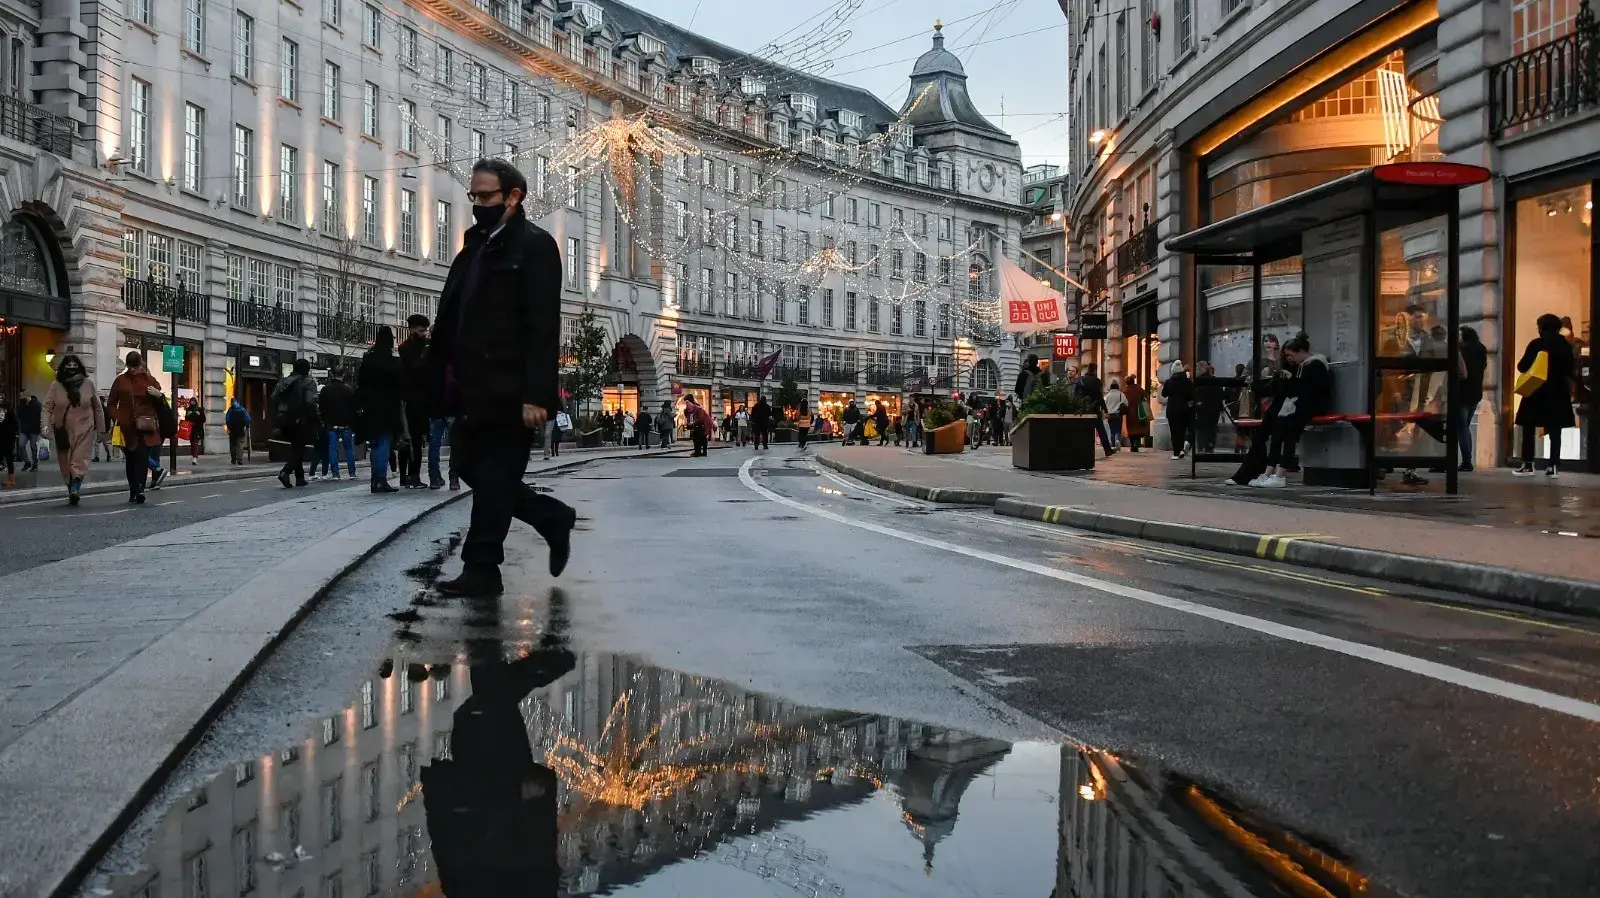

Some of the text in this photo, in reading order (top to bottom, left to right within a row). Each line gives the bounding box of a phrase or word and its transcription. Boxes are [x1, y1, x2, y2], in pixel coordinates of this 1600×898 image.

[1037, 302, 1054, 310] UNI
[1039, 310, 1057, 320] QLO
[1056, 338, 1072, 346] UNI
[1056, 347, 1073, 356] QLO
